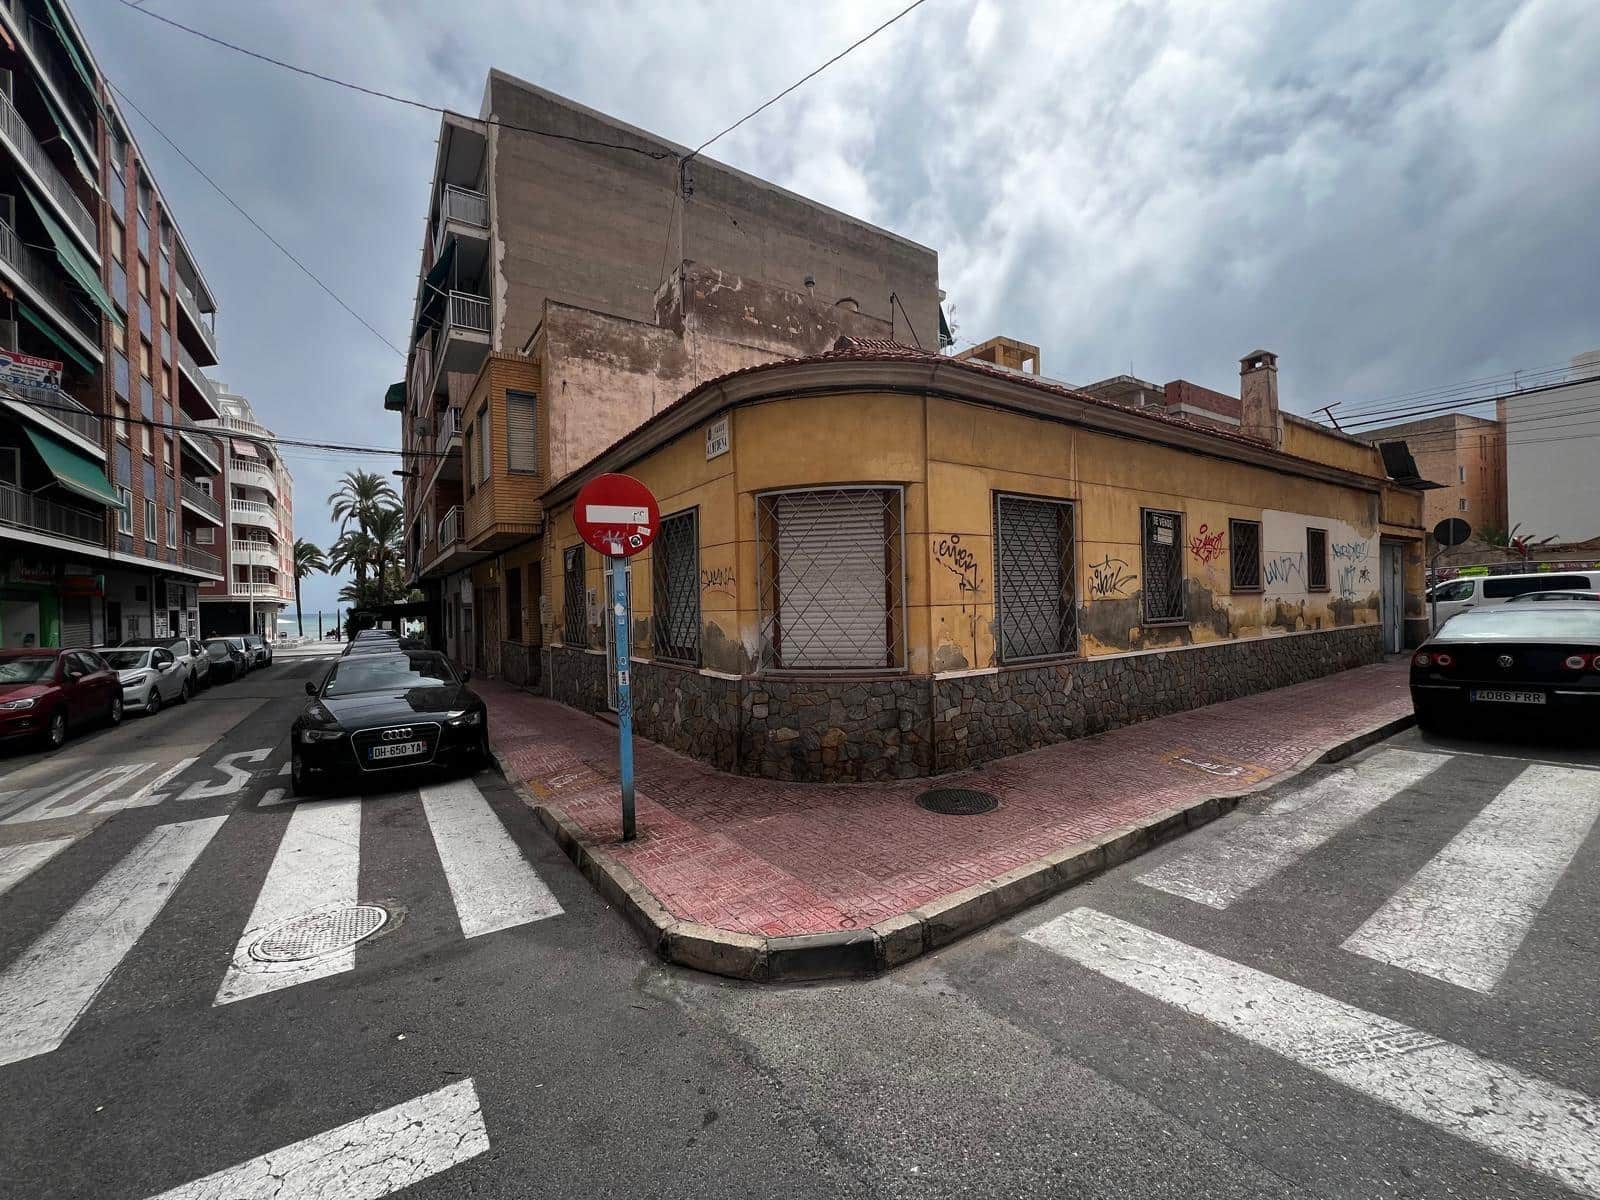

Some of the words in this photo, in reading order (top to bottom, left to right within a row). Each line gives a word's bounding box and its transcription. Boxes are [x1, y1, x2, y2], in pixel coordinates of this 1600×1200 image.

[20, 357, 54, 368] VENDE
[1479, 691, 1511, 701] 4086
[1515, 692, 1541, 703] FRR
[374, 743, 421, 758] DH-650-YA
